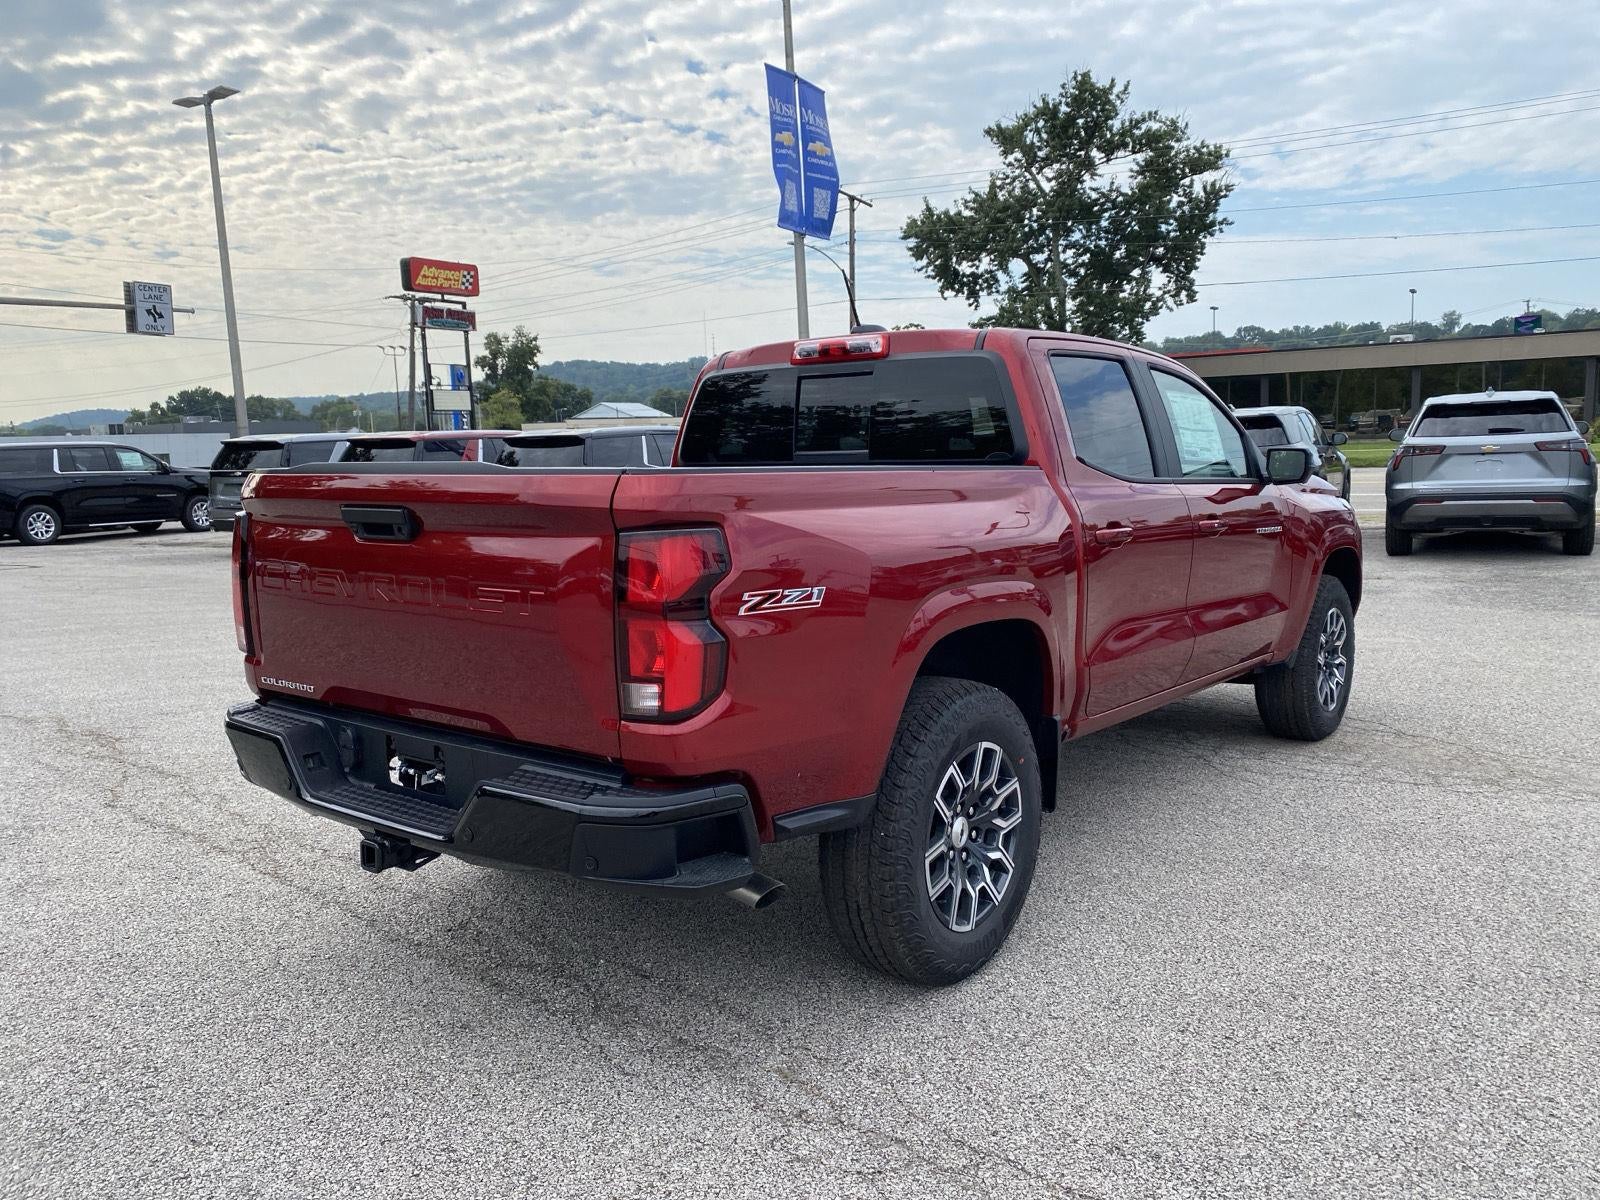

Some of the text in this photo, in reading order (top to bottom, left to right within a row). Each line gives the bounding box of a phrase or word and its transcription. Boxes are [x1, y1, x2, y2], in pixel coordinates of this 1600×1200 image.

[421, 265, 460, 280] Advance
[415, 276, 460, 288] Auto Parts
[138, 284, 168, 294] CENTER
[143, 293, 164, 301] LANE
[145, 323, 165, 331] ONLY
[261, 561, 545, 616] CHEVROLET
[738, 586, 827, 616] Z71
[260, 676, 315, 693] COLORADO
